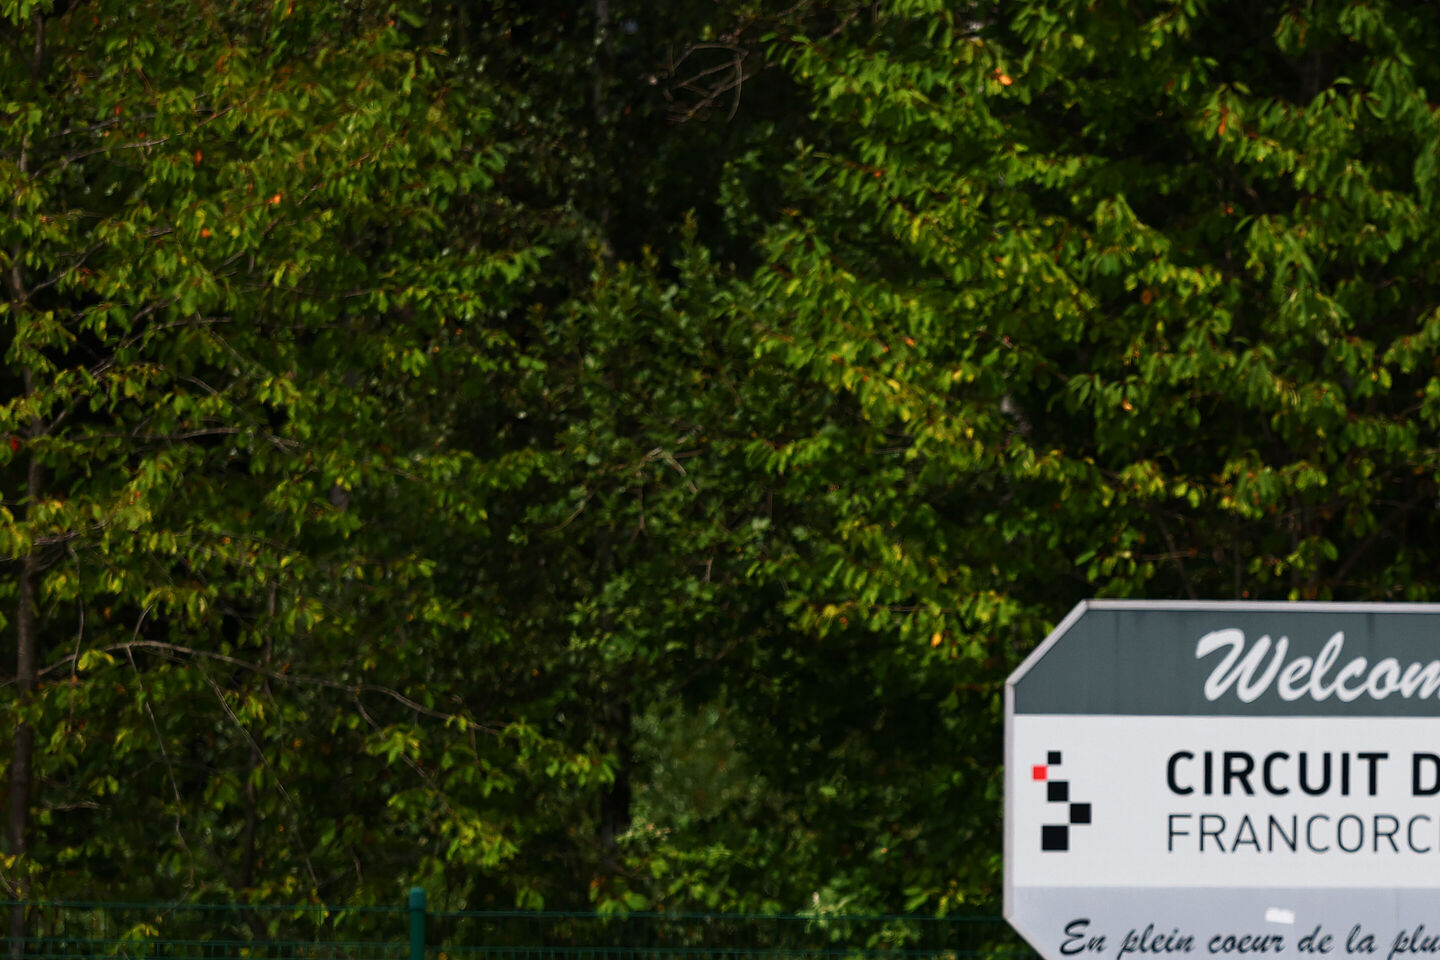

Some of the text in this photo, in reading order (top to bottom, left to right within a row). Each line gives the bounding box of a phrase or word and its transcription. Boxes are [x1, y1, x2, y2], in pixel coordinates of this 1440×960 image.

[1166, 750, 1390, 797] CIRCUIT
[1059, 918, 1108, 957] En
[1207, 934, 1286, 955] coeur
[1297, 925, 1335, 955] de
[1345, 924, 1378, 955] la
